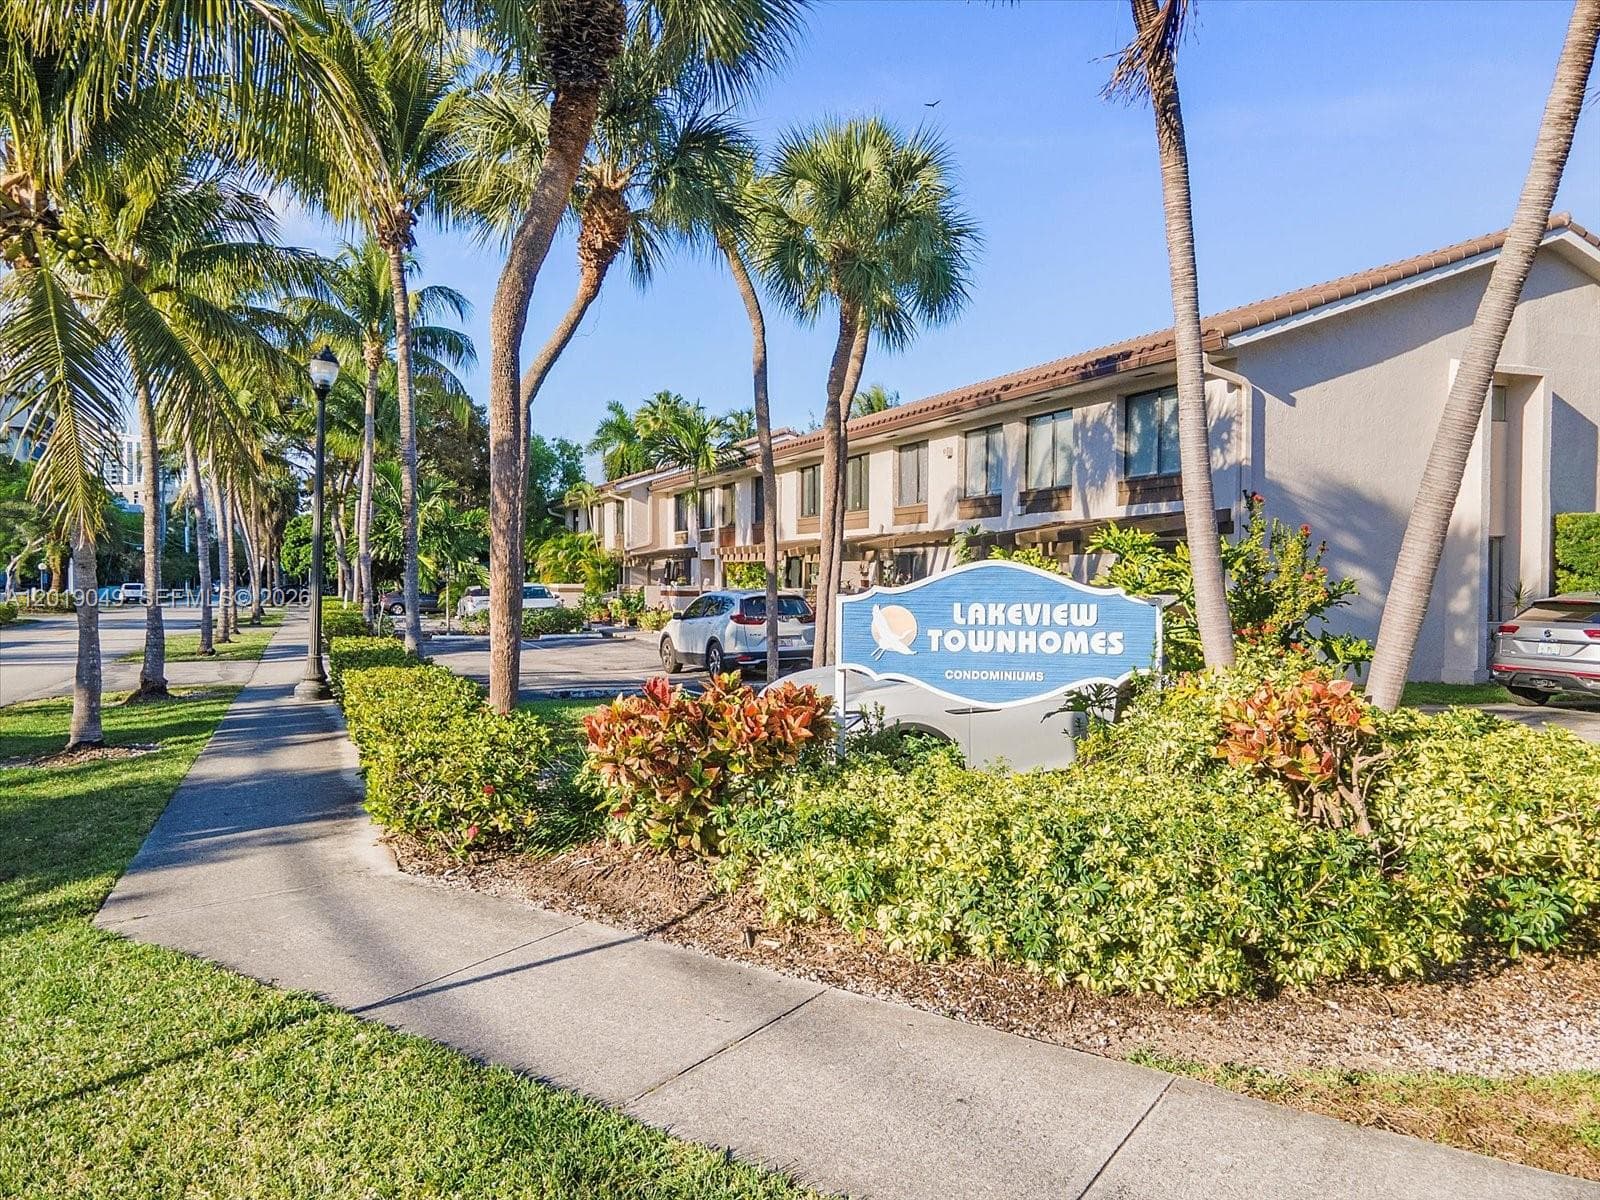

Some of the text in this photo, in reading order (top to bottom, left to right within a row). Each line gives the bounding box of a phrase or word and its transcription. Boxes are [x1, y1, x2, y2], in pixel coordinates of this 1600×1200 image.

[953, 602, 1098, 627] LAKEVIEW
[927, 629, 1125, 655] TOWNHOMES
[944, 669, 1046, 682] CONDOMINIUMS
